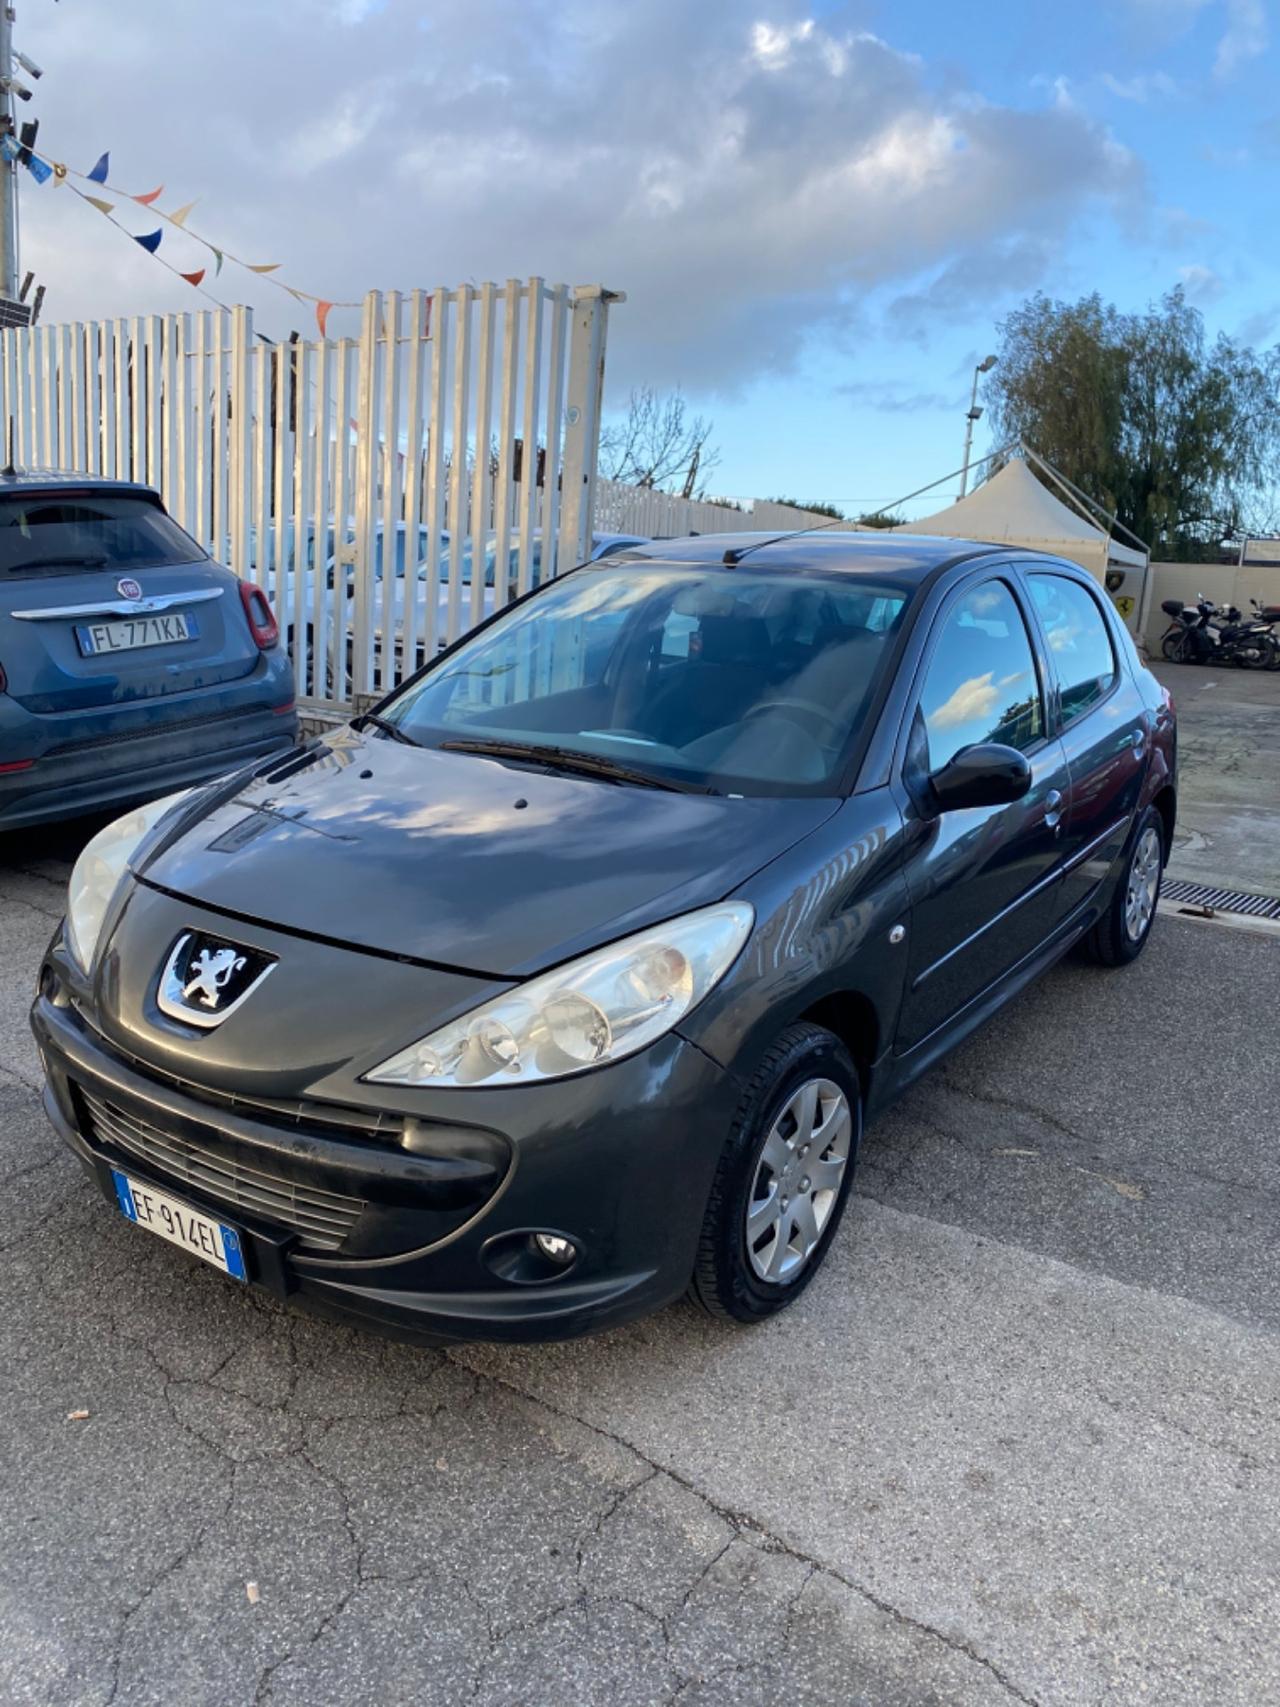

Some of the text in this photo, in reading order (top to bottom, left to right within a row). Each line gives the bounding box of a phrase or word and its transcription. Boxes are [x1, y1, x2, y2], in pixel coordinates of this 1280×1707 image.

[93, 617, 187, 650] FL 771KA
[132, 1190, 225, 1262] EF 914EL
